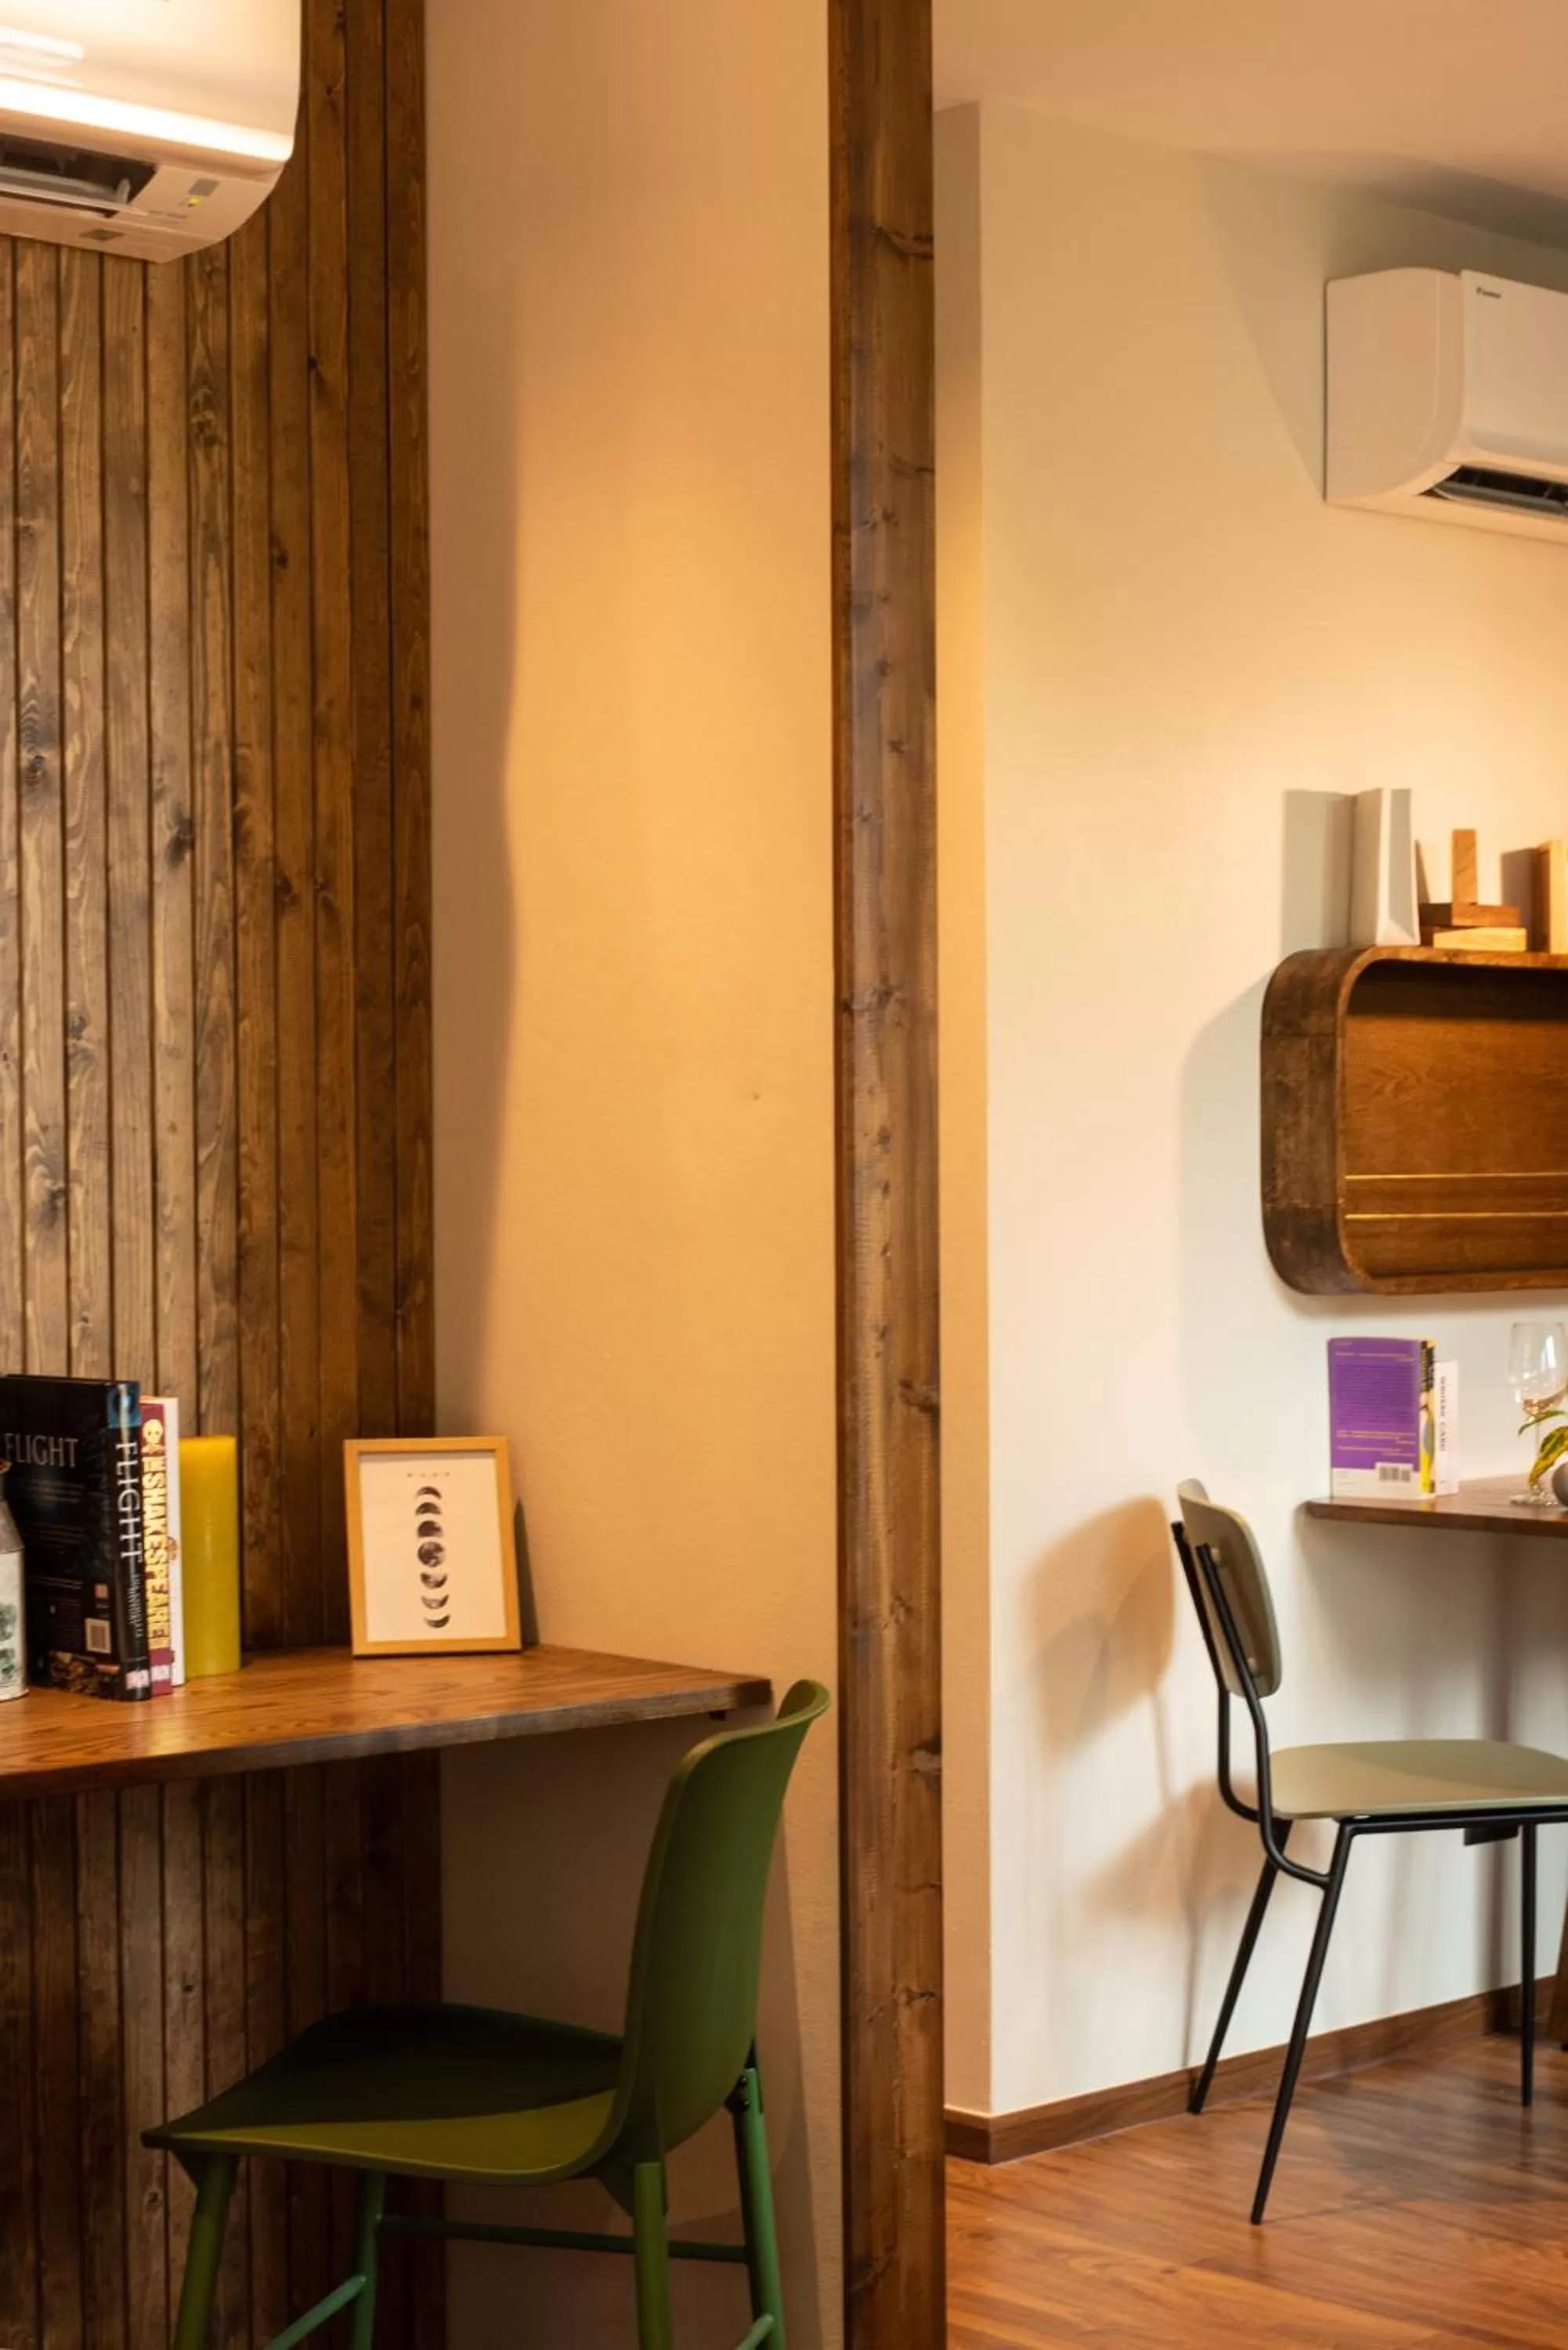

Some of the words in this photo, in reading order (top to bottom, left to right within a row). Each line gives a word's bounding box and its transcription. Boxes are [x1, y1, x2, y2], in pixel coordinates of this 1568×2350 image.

[4, 1433, 79, 1468] FLIGHT
[115, 1441, 143, 1564] FLIGHT
[142, 1472, 170, 1639] SHAKESPEARE
